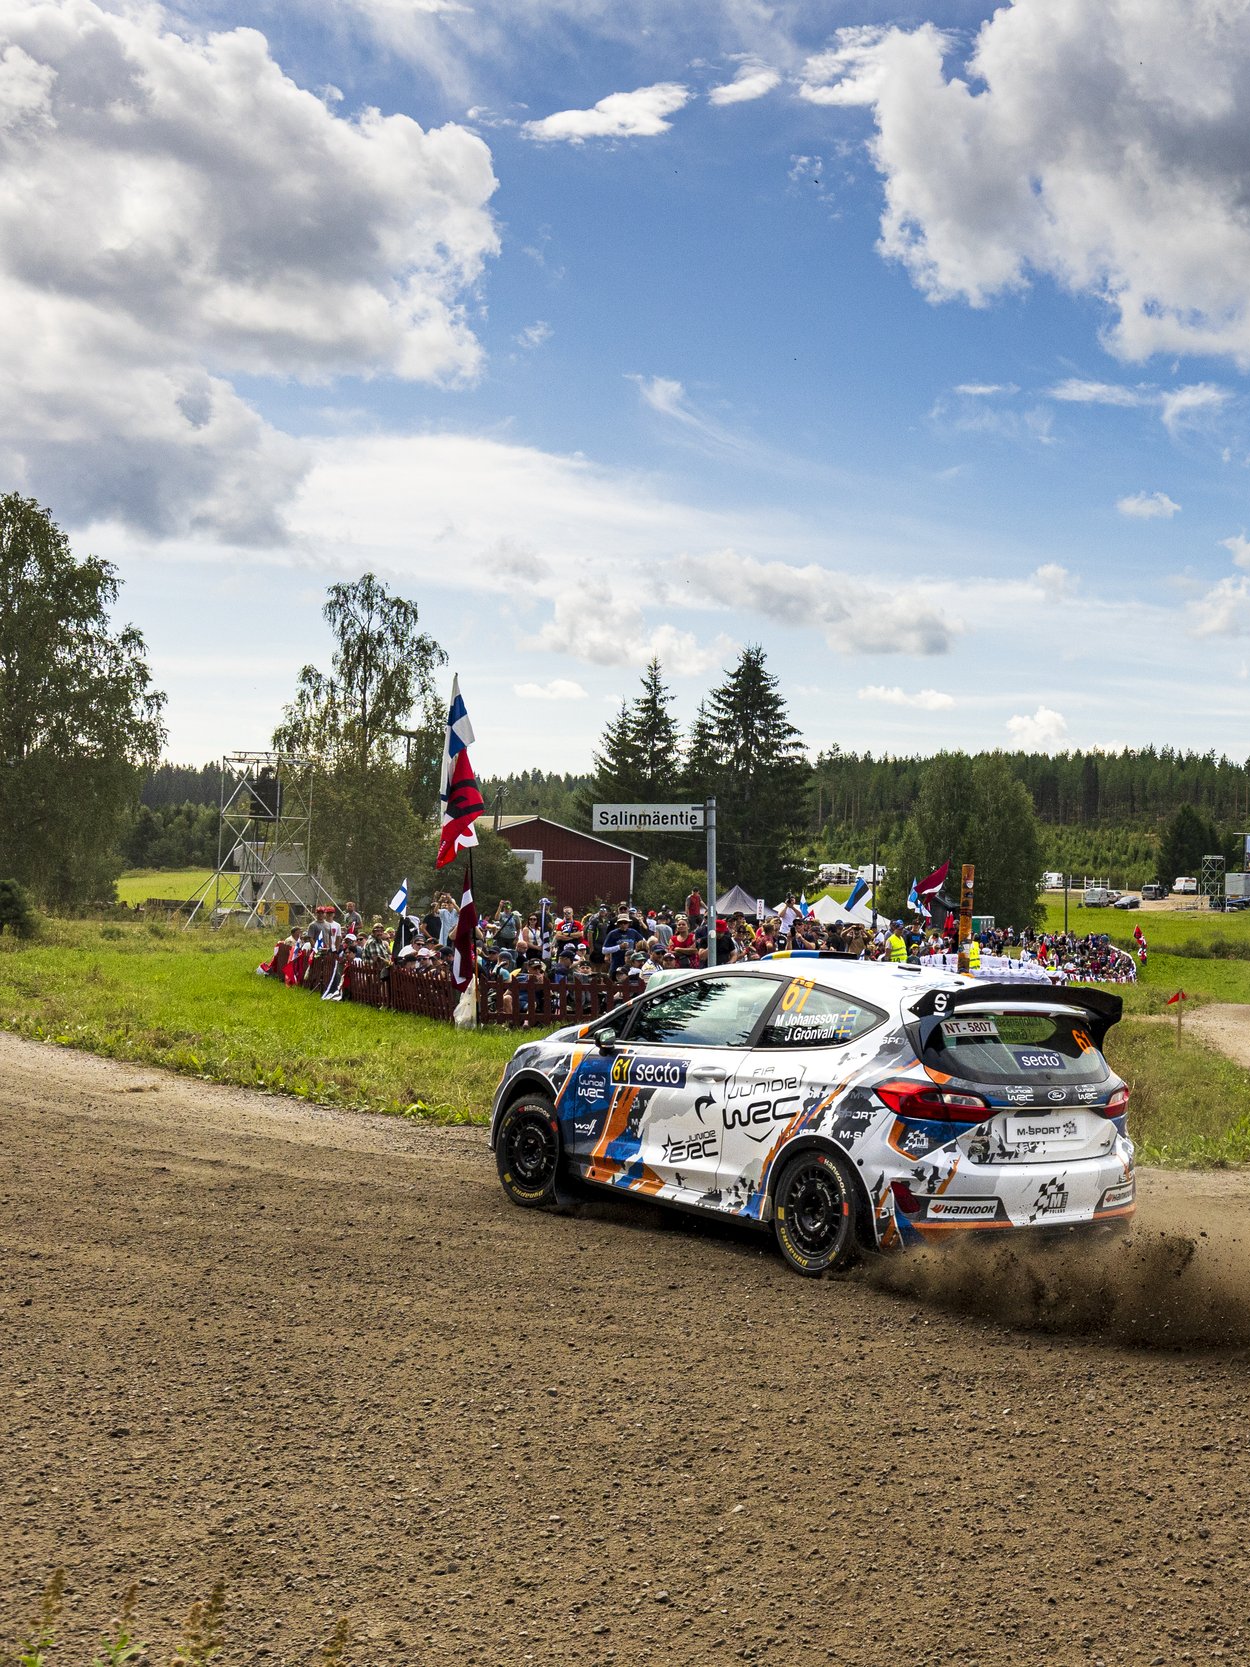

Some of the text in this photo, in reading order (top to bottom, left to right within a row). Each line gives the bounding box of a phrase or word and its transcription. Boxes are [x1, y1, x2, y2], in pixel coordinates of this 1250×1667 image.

[599, 811, 698, 826] Salinmäentie
[781, 976, 816, 1013] 61
[774, 1013, 840, 1027] M Johansson
[785, 1025, 836, 1041] J Grönvall
[1071, 1029, 1097, 1055] 61
[1021, 1054, 1060, 1067] secto
[612, 1058, 632, 1081] 61
[635, 1061, 680, 1084] secto
[753, 1066, 775, 1077] FIA
[577, 1086, 605, 1099] WRC
[728, 1076, 797, 1099] JUNIOR
[1077, 1092, 1098, 1100] WRC
[722, 1095, 800, 1130] WRC
[684, 1129, 716, 1144] JUNIOR
[1016, 1126, 1061, 1136] M-SPORT
[669, 1139, 719, 1163] ERC
